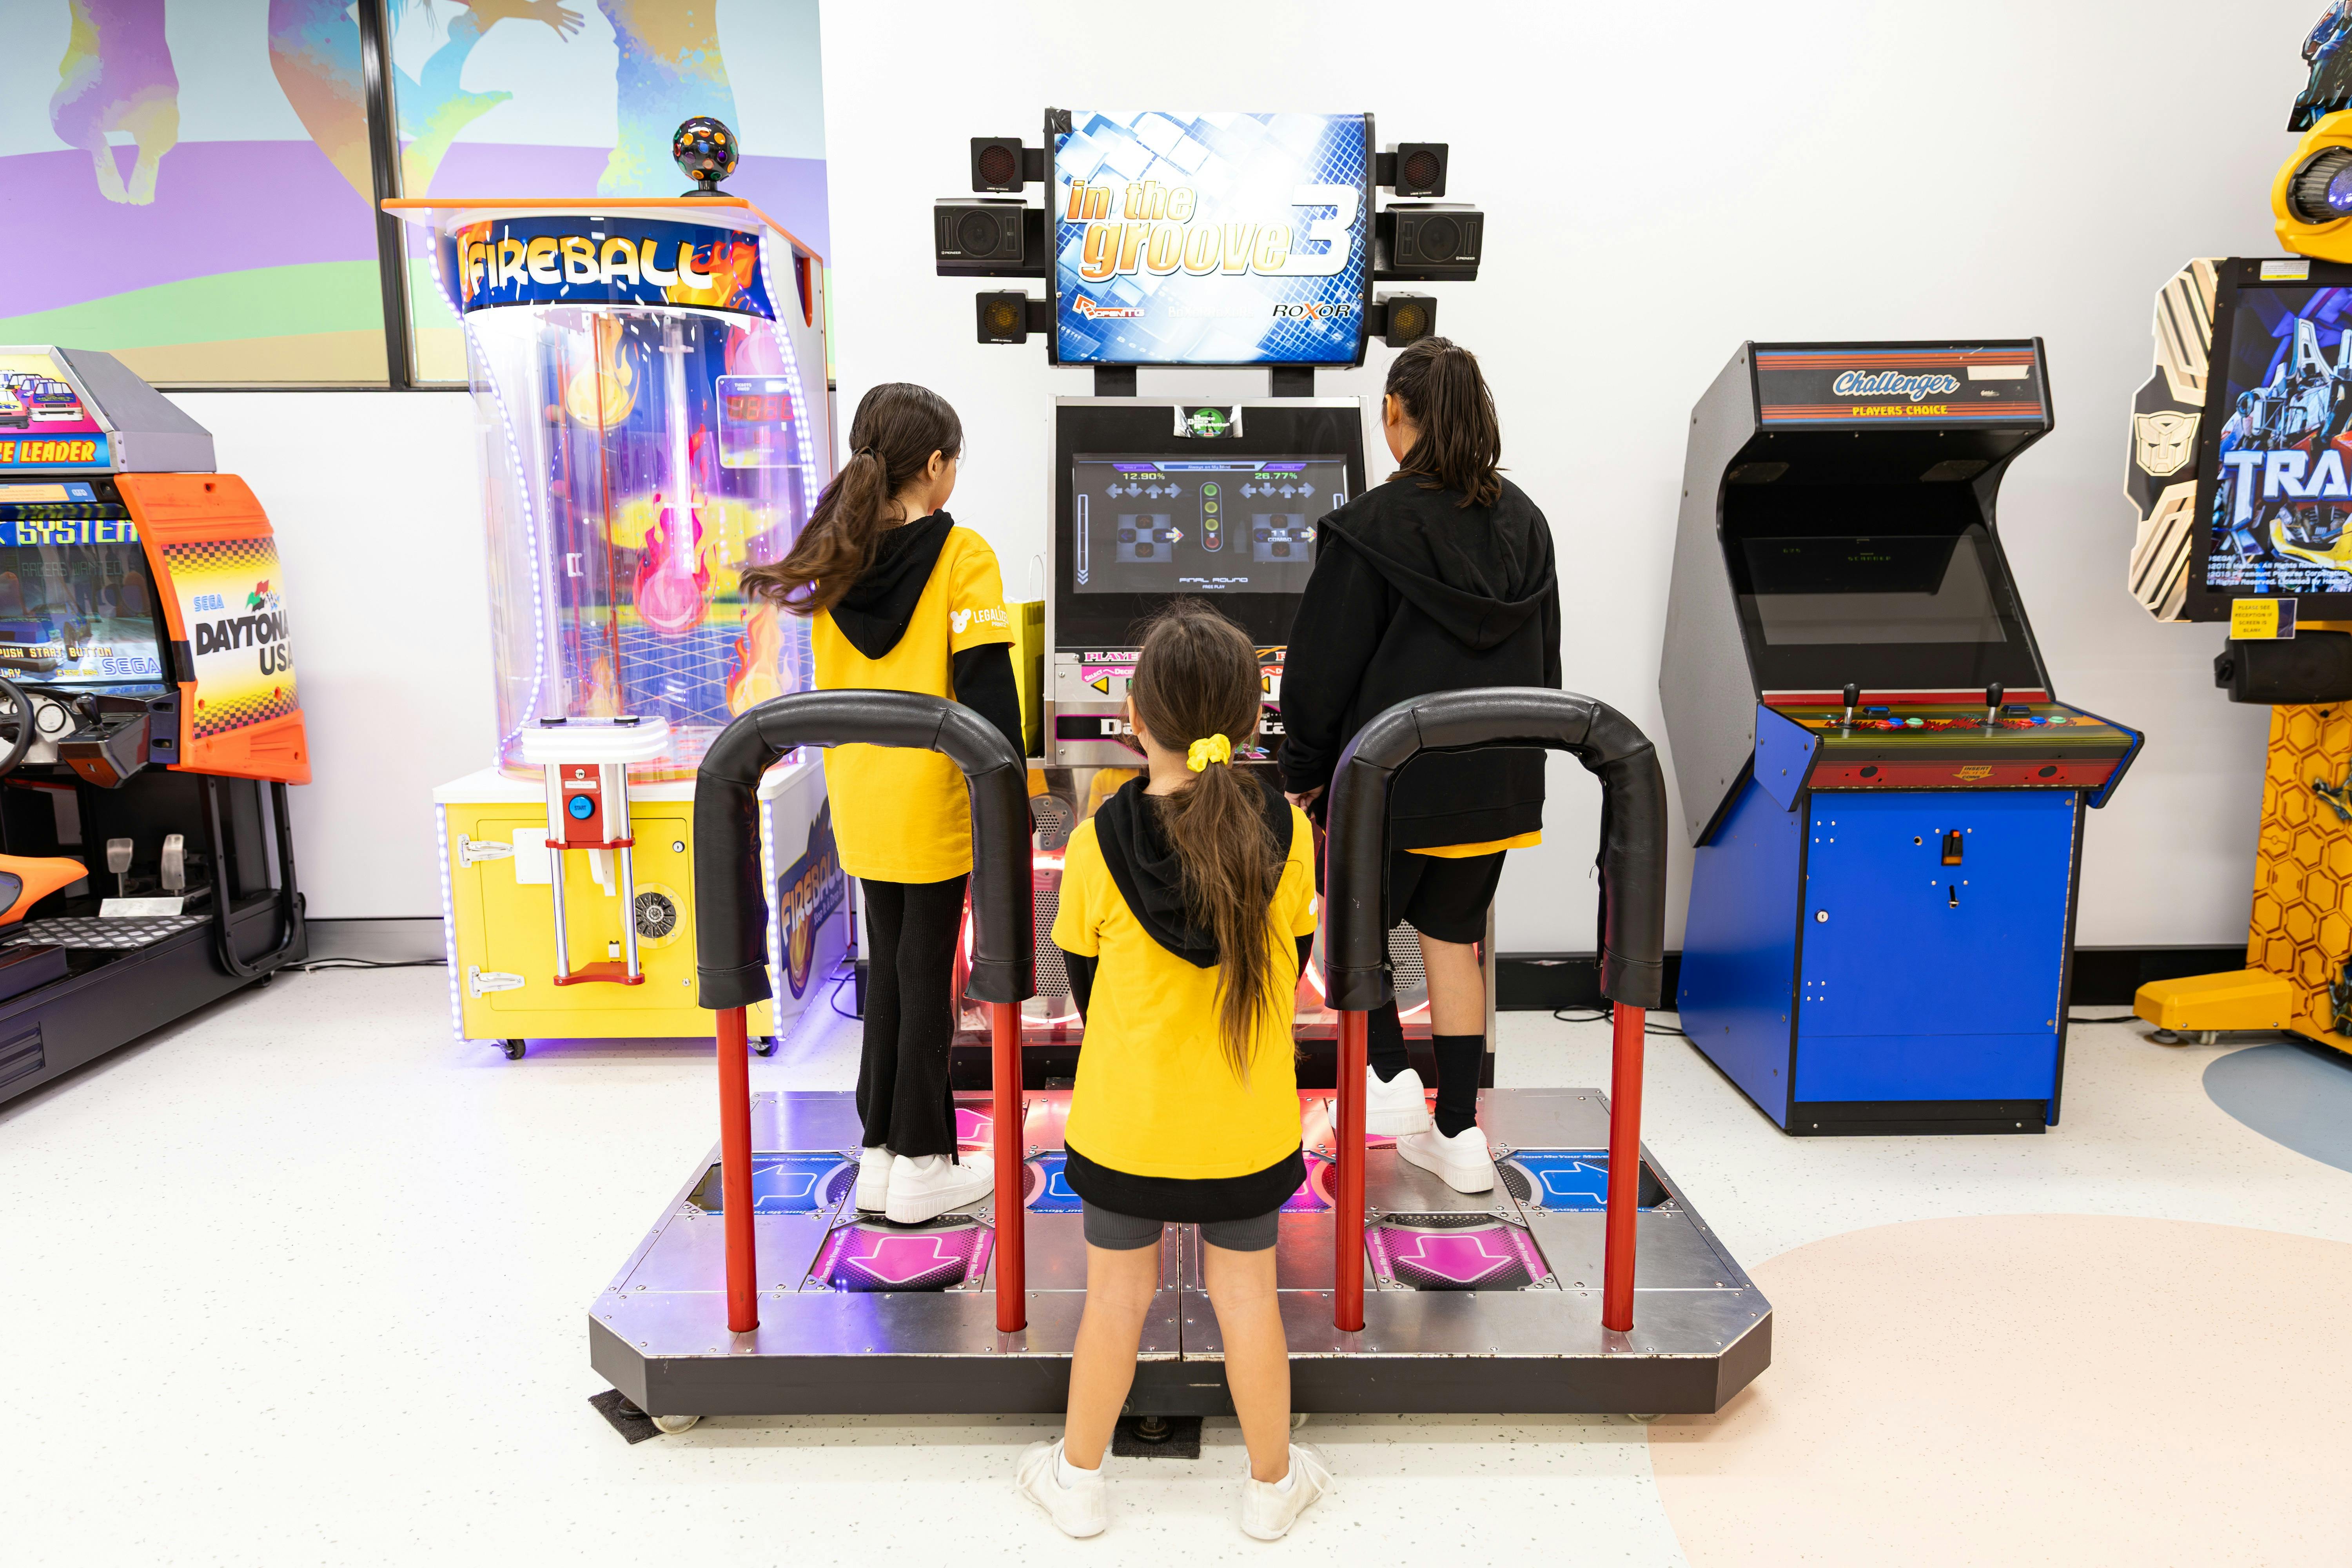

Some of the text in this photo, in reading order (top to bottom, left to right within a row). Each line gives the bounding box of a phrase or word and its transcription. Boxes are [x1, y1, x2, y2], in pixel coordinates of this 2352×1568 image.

[1067, 180, 1194, 220] in the
[1081, 184, 1359, 279] groove 3
[468, 235, 713, 295] FIREBALL
[1834, 370, 1960, 401] Challenger
[1852, 405, 1947, 416] PLAYERS CHOICE
[20, 441, 96, 463] LEADER
[2224, 450, 2352, 526] TRA
[193, 594, 224, 612] SEGA
[196, 609, 290, 656] DAYTONA
[29, 648, 63, 659] START
[69, 647, 113, 657] BUTTON
[259, 641, 294, 676] USA
[0, 668, 21, 678] LAY
[102, 657, 162, 675] SEGA
[835, 1229, 849, 1246] Moves
[828, 1246, 841, 1259] Your
[972, 1251, 982, 1263] Your
[1376, 1245, 1385, 1257] Your
[1521, 1250, 1532, 1263] Your
[825, 1258, 835, 1267] Me
[1379, 1257, 1388, 1265] Me
[967, 1263, 978, 1279] Move
